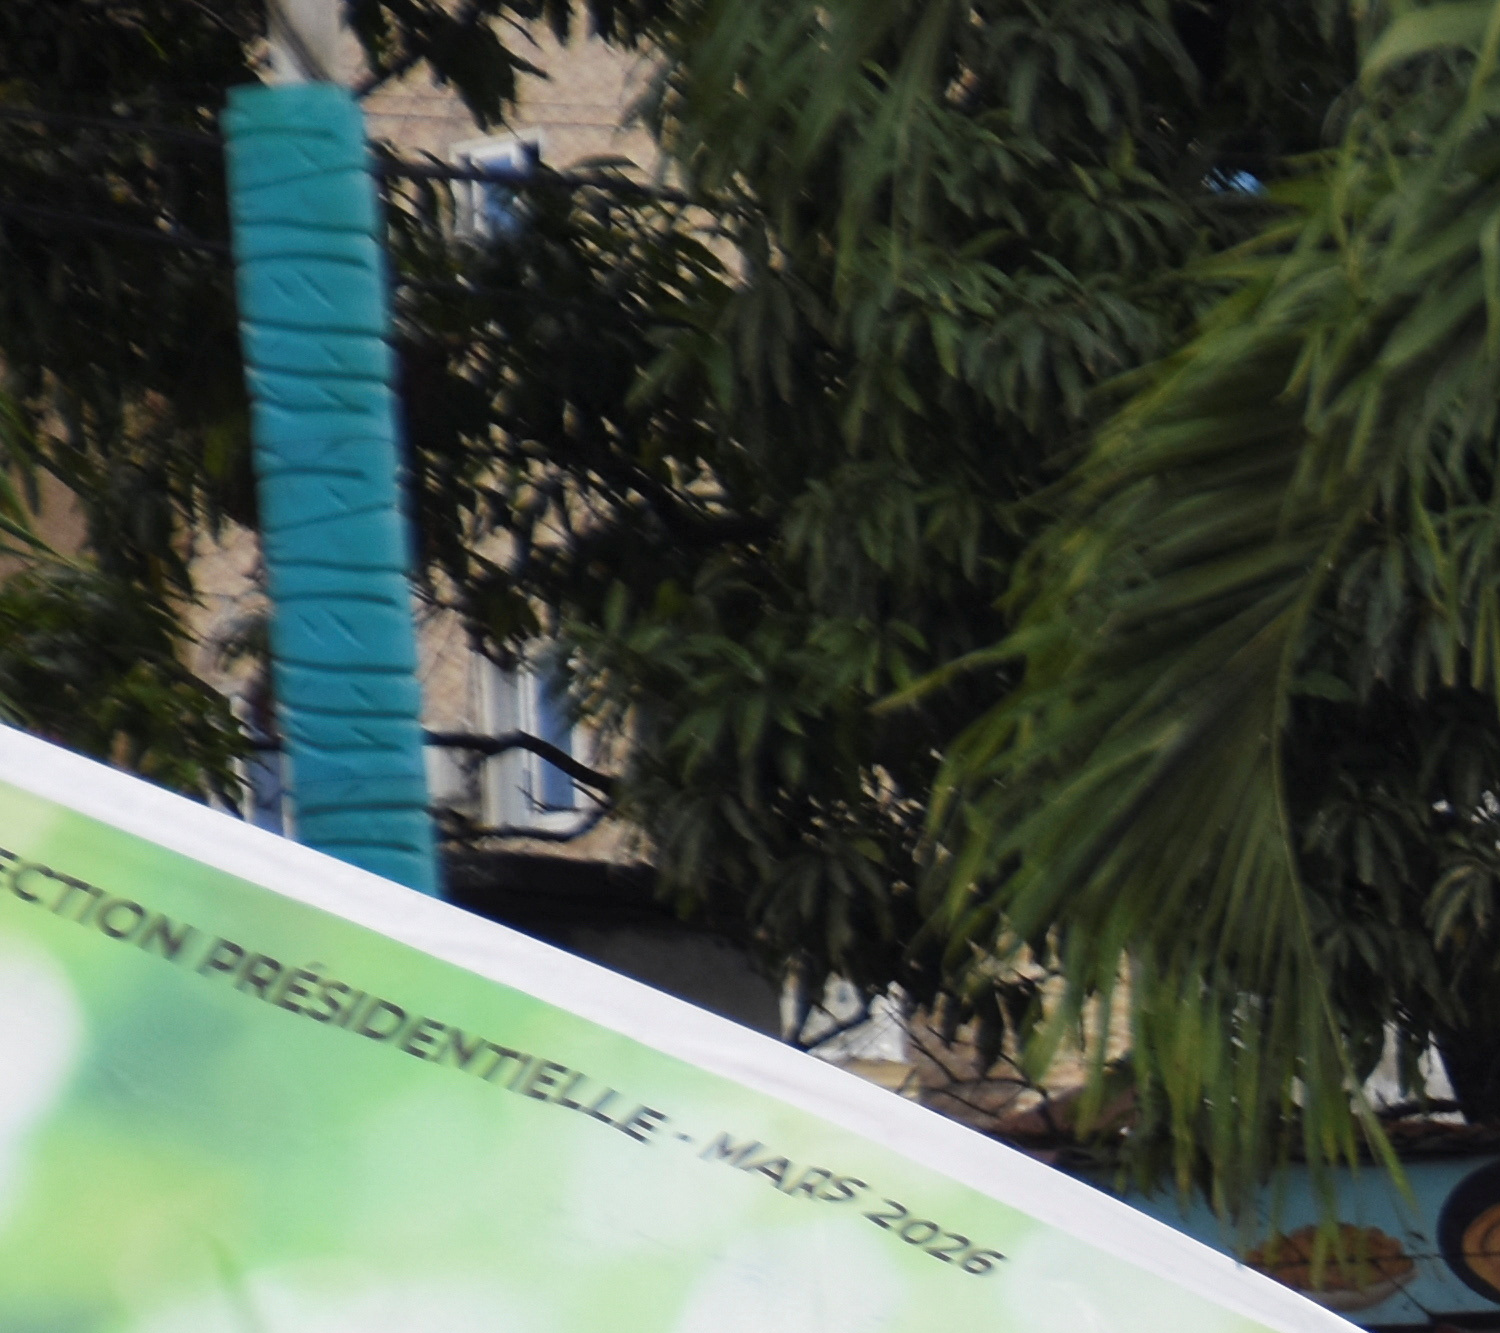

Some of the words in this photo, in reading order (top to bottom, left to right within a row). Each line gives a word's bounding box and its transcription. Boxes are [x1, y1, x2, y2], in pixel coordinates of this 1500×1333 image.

[196, 934, 668, 1146] PRÉSIDENTIELLE
[698, 1129, 872, 1204] MARS
[862, 1196, 1010, 1278] 2026
